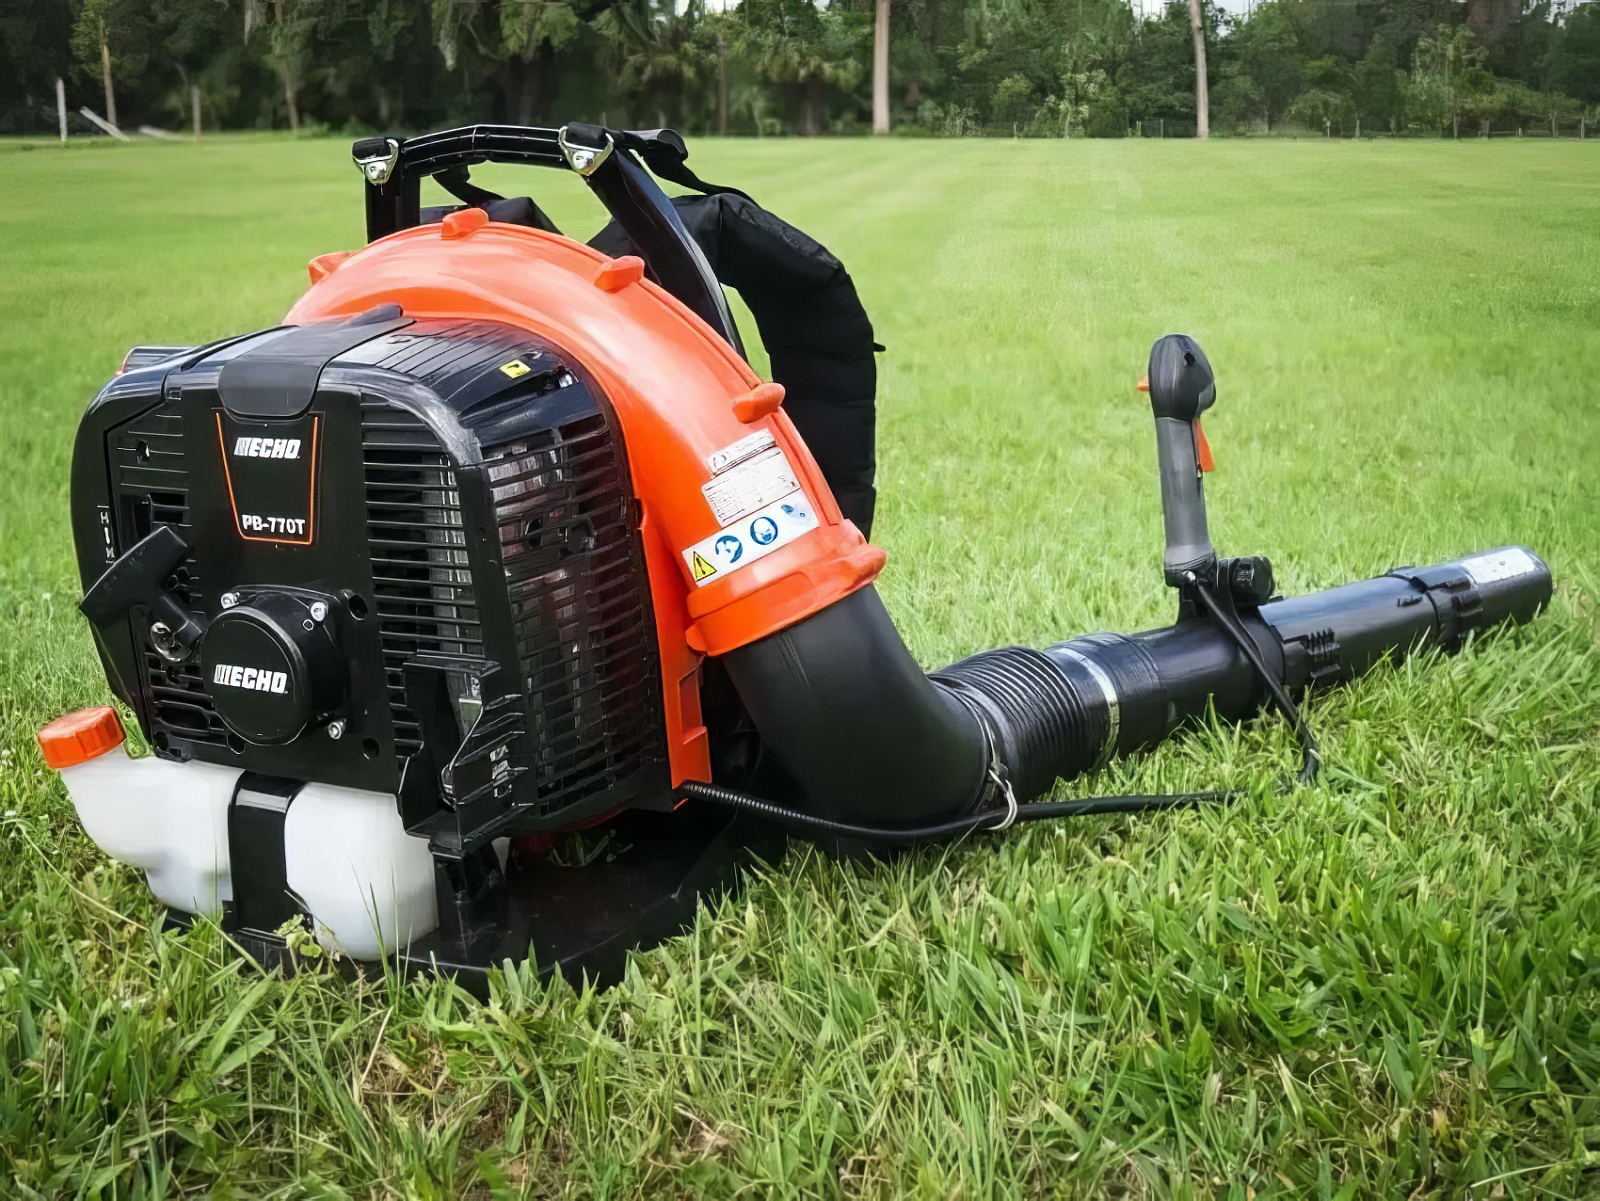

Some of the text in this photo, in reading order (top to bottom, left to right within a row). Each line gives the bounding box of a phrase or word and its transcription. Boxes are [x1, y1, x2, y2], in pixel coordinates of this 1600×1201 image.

[247, 437, 301, 459] ECHO
[241, 514, 306, 535] PB-770T
[230, 665, 289, 694] ECHO
